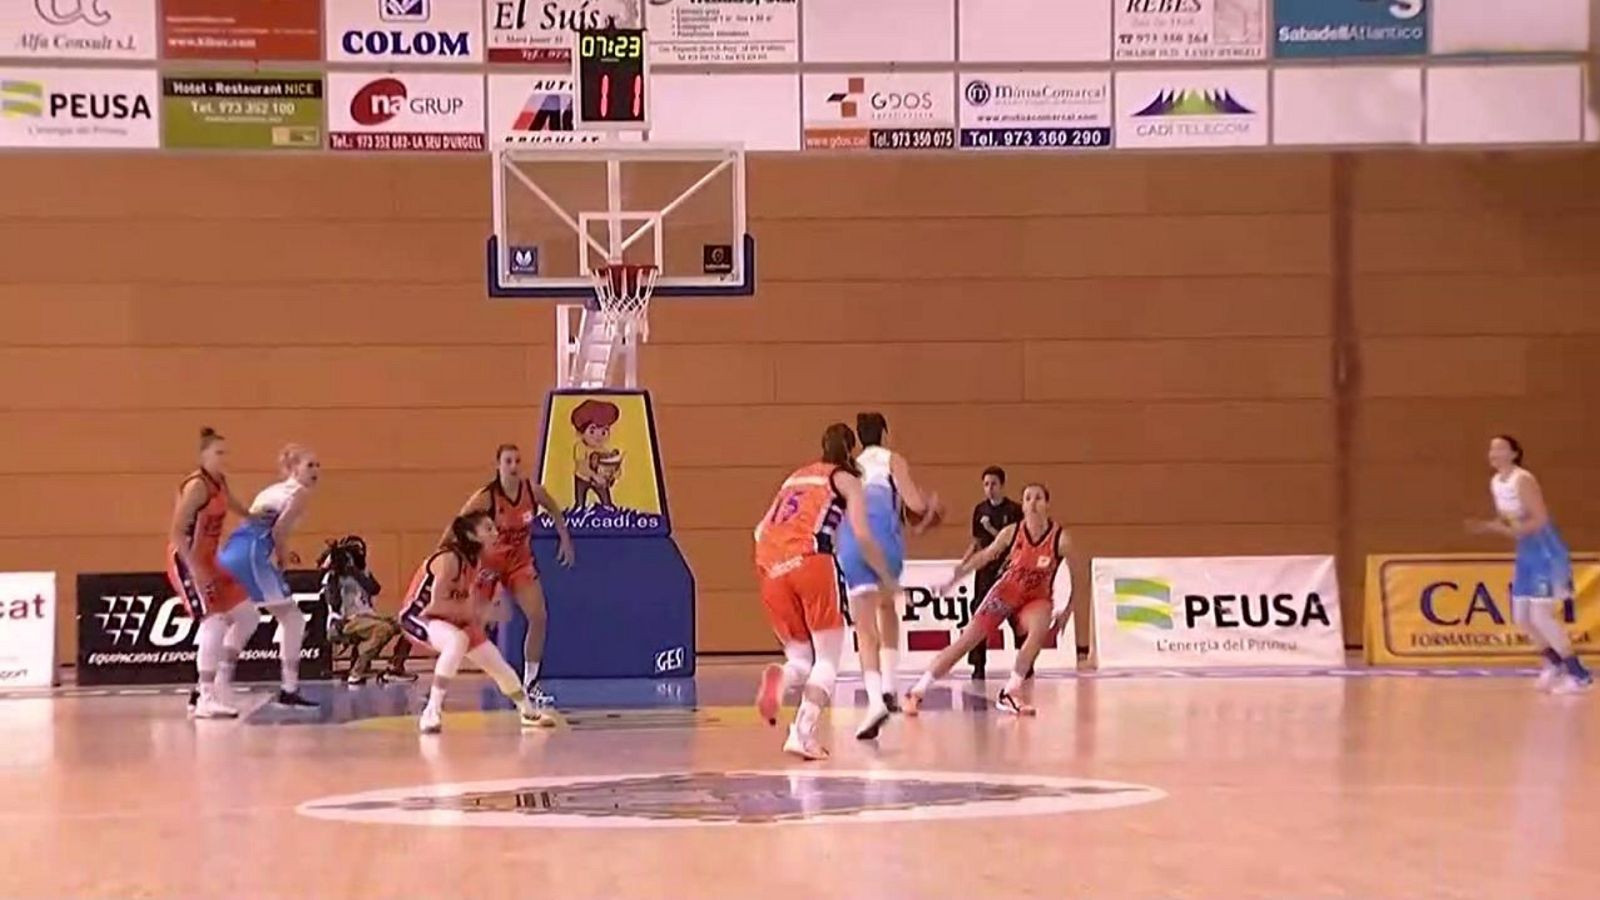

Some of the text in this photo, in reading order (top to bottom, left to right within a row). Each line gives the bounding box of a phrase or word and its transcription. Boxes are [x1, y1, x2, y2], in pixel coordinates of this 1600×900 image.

[494, 0, 525, 30] El
[342, 30, 469, 56] COLOM
[582, 36, 641, 57] 07:23
[173, 82, 315, 94] Hotel Restaurant NICE
[51, 94, 151, 119] PEUSA
[410, 98, 463, 114] GRUP
[891, 131, 911, 148] 973
[1003, 130, 1033, 146] 973
[1072, 129, 1102, 146] 290
[1184, 592, 1330, 629] PEUSA
[1223, 640, 1244, 651] del
